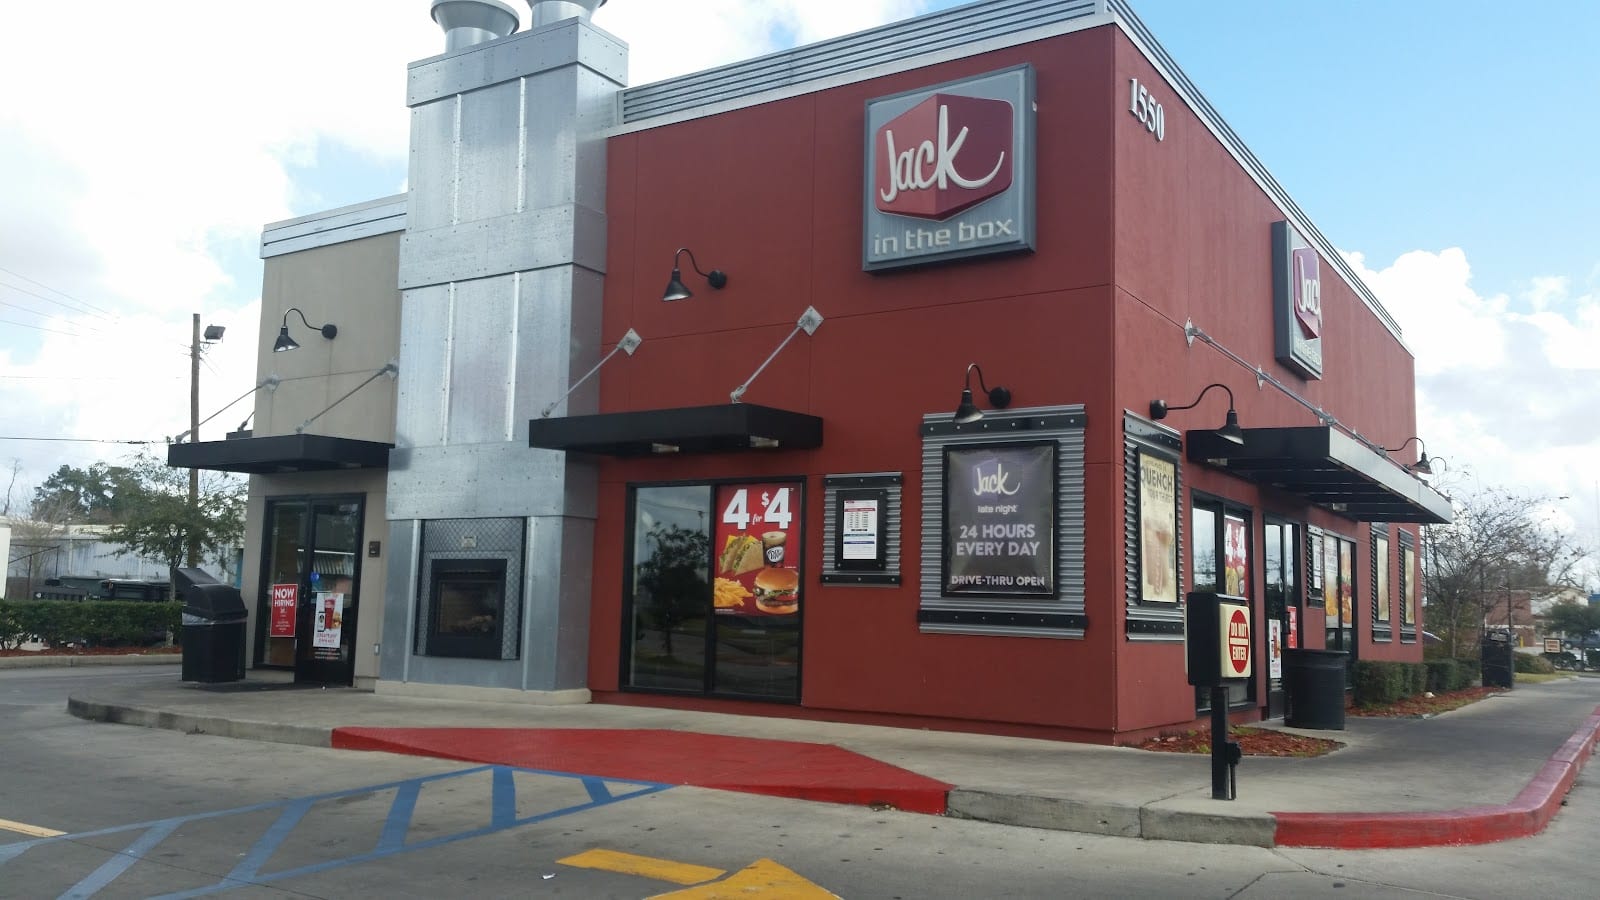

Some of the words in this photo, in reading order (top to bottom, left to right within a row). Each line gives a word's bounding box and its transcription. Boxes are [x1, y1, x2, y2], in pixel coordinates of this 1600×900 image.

[1128, 78, 1165, 141] 1550
[880, 104, 1005, 203] Jack
[874, 234, 898, 255] in
[905, 228, 950, 250] the
[958, 219, 1013, 242] box
[973, 463, 1021, 496] Jack
[723, 489, 750, 530] 4
[977, 505, 994, 513] late
[995, 505, 1017, 515] night
[960, 525, 978, 539] 24
[982, 524, 1036, 539] HOURS
[956, 542, 1005, 556] EVERY
[1008, 542, 1040, 556] DAY
[951, 575, 1014, 586] DRIVE-THRU
[1016, 576, 1045, 587] OPEN
[274, 588, 295, 600] NOW
[274, 599, 294, 608] HIRING
[1231, 622, 1238, 636] DO
[1238, 623, 1247, 637] NOT
[1232, 646, 1247, 661] ENTER
